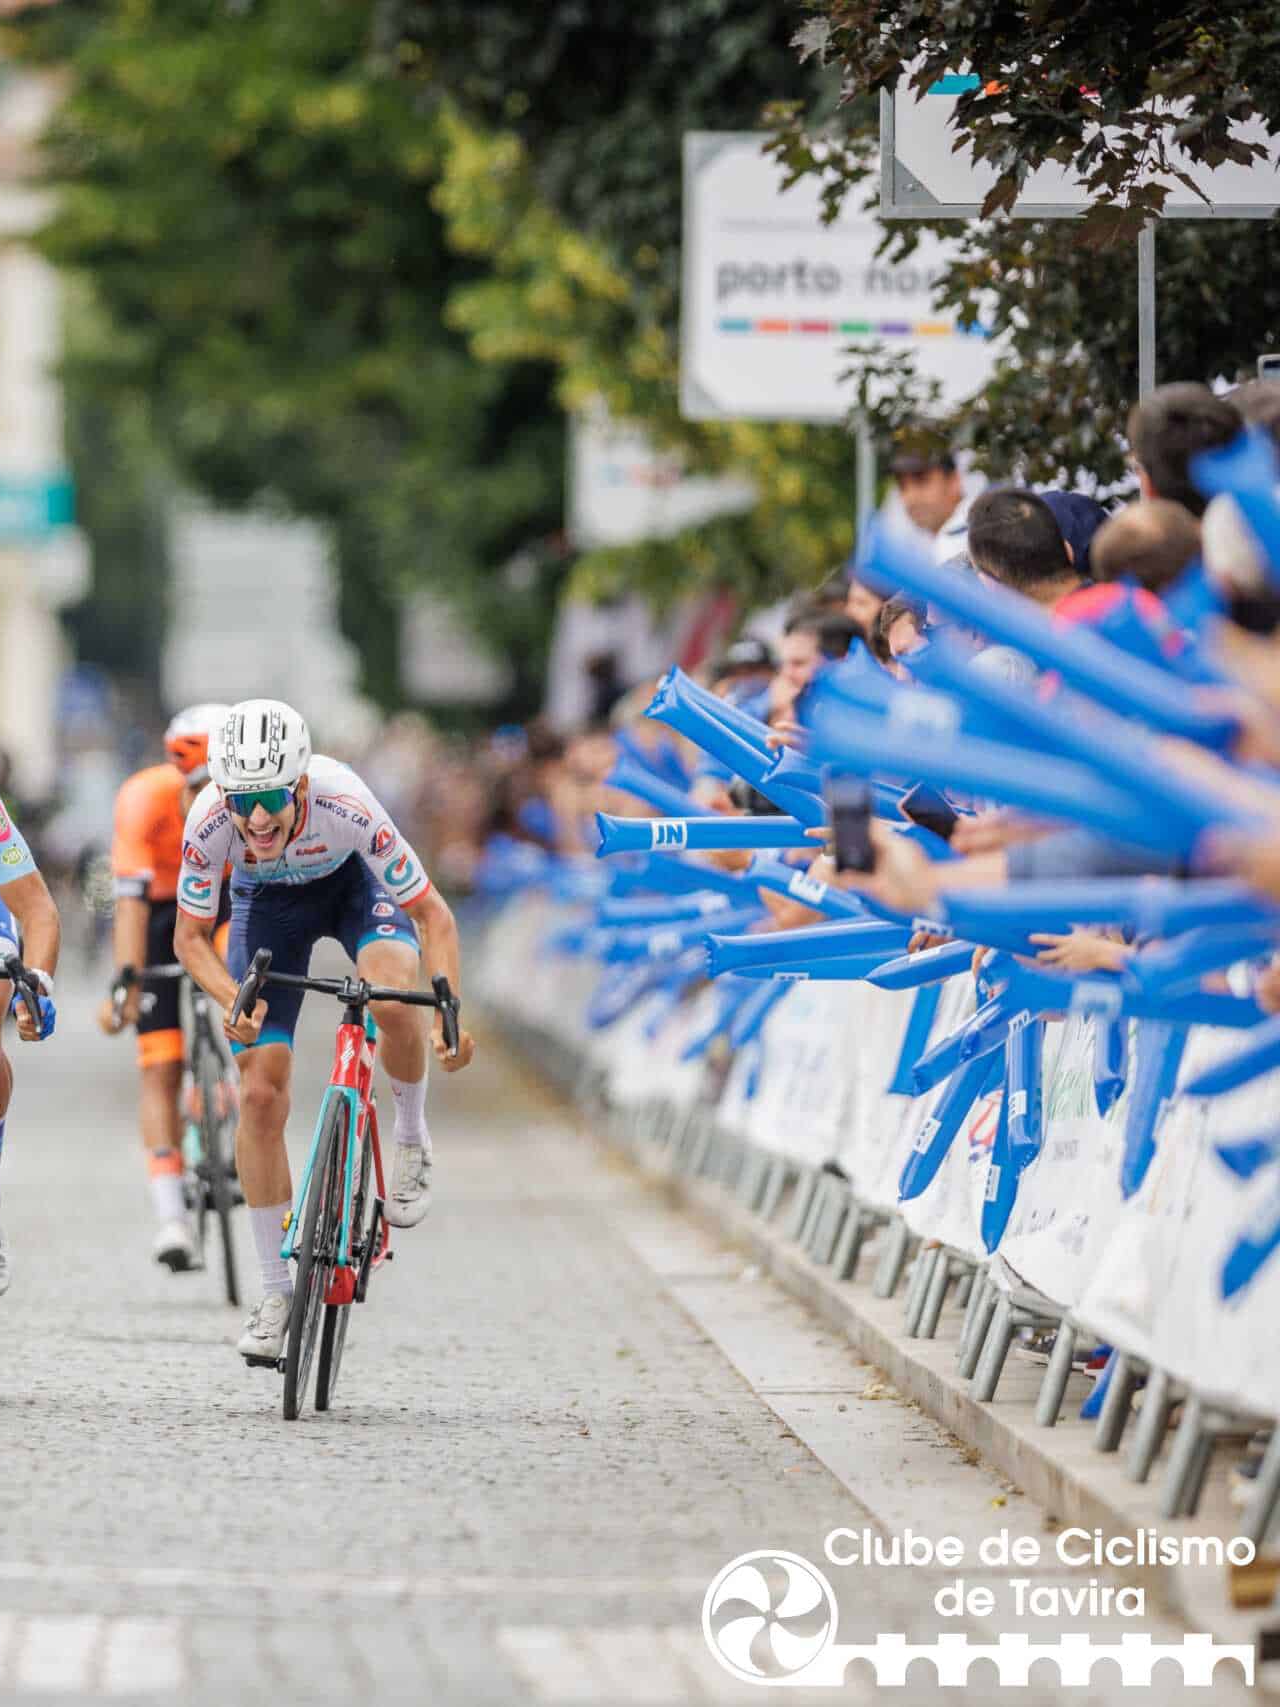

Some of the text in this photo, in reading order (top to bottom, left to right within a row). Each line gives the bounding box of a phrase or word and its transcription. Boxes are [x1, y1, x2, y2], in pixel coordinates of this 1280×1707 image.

[717, 259, 841, 298] porto
[198, 813, 229, 842] MARCOS
[315, 798, 369, 831] MARCOS CAR
[656, 823, 683, 845] JN
